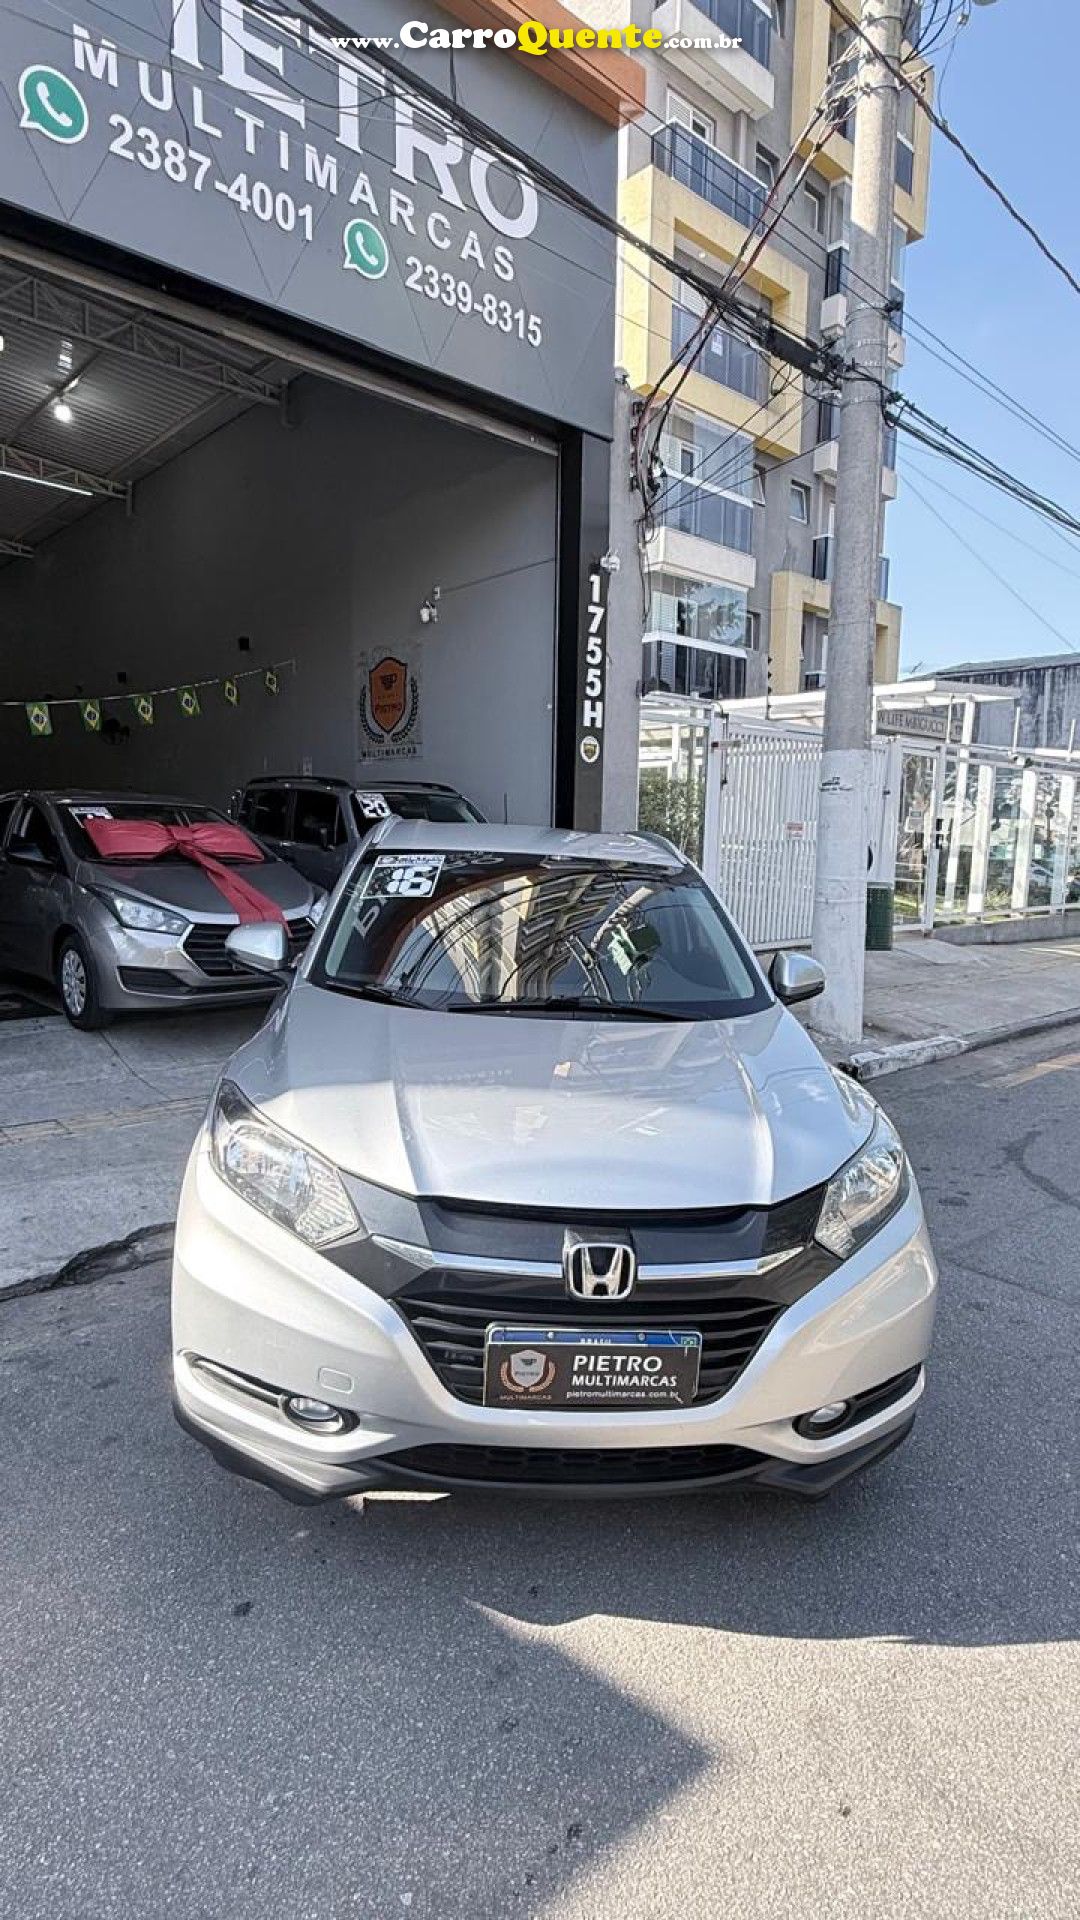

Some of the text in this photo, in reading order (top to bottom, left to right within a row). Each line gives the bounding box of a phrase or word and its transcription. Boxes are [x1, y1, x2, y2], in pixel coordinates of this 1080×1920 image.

[72, 23, 517, 282] MULTIMARCAS
[108, 113, 314, 242] 2387-4001
[404, 255, 543, 348] 2339-8315
[582, 573, 605, 729] 1755H
[386, 866, 433, 896] 16
[571, 1374, 678, 1387] MULTIMARCAS
[572, 1355, 663, 1372] PIETRO
